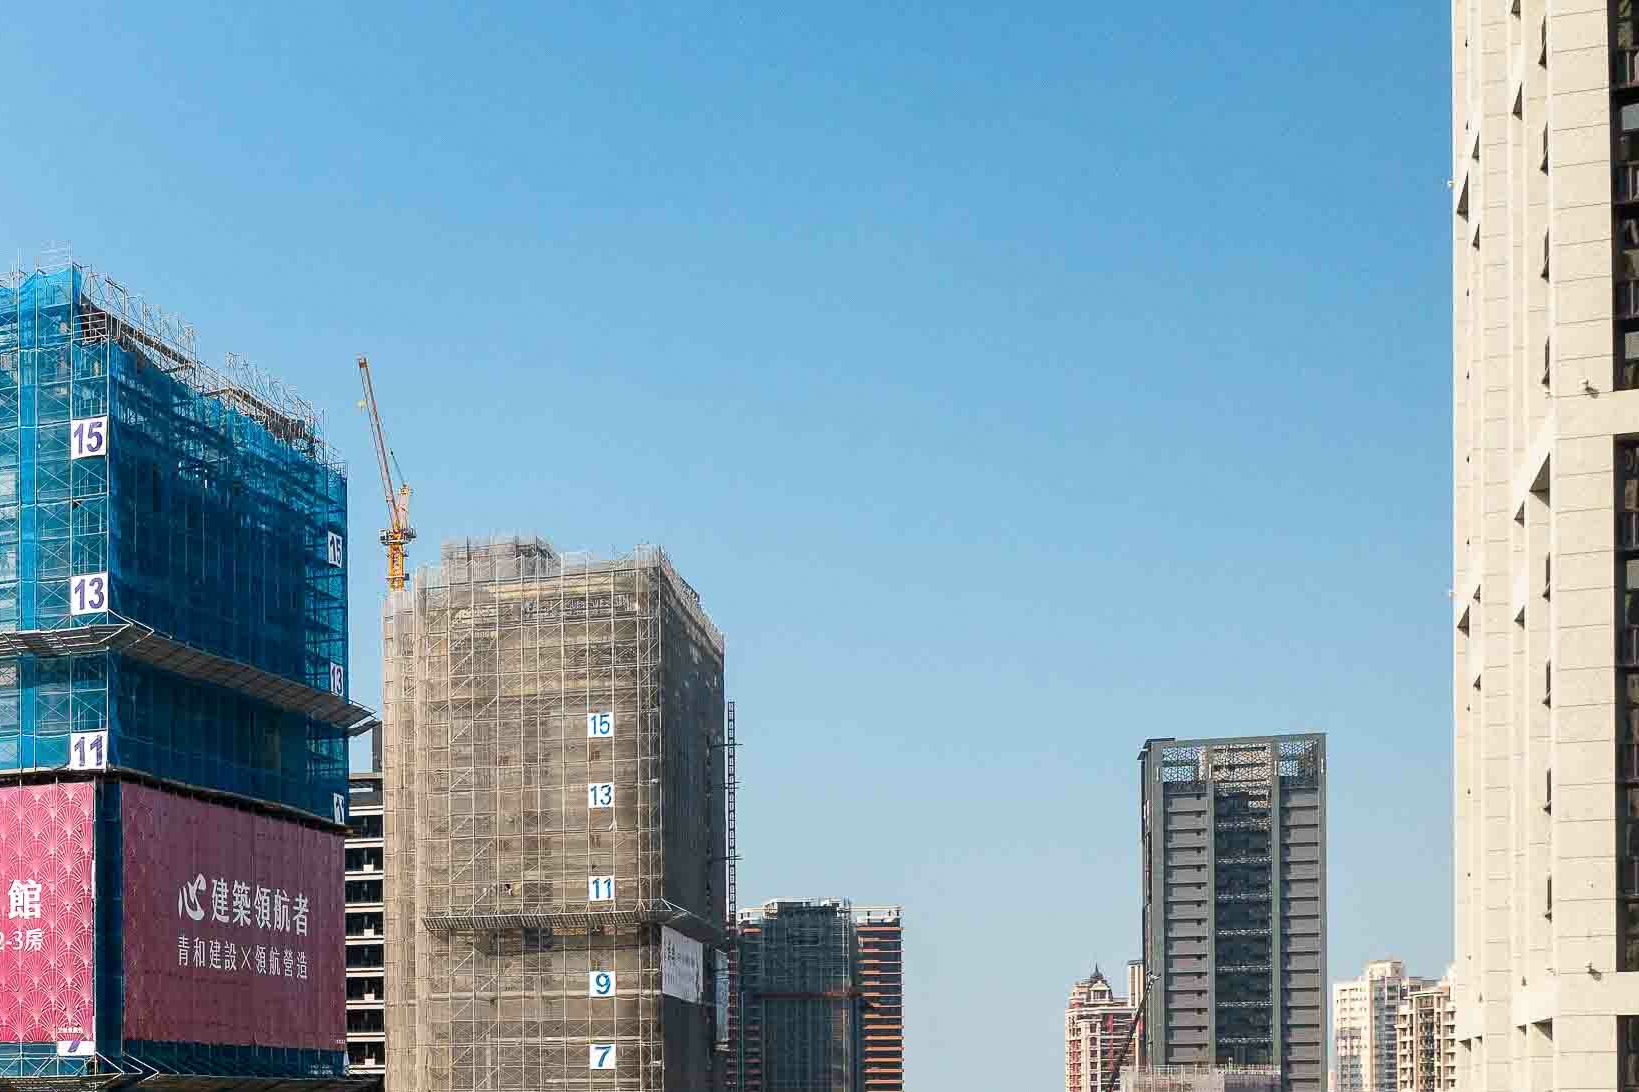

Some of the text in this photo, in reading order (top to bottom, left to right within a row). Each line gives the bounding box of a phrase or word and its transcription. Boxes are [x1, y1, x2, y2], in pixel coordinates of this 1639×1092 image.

[72, 420, 103, 454] 15
[329, 535, 342, 565] 15
[73, 577, 105, 611] 13
[331, 666, 343, 694] 13
[590, 714, 610, 735] 15
[73, 734, 105, 767] 11
[590, 784, 612, 806] 13
[592, 878, 612, 899] 11
[595, 972, 611, 995] 9
[594, 1045, 612, 1067] 7
